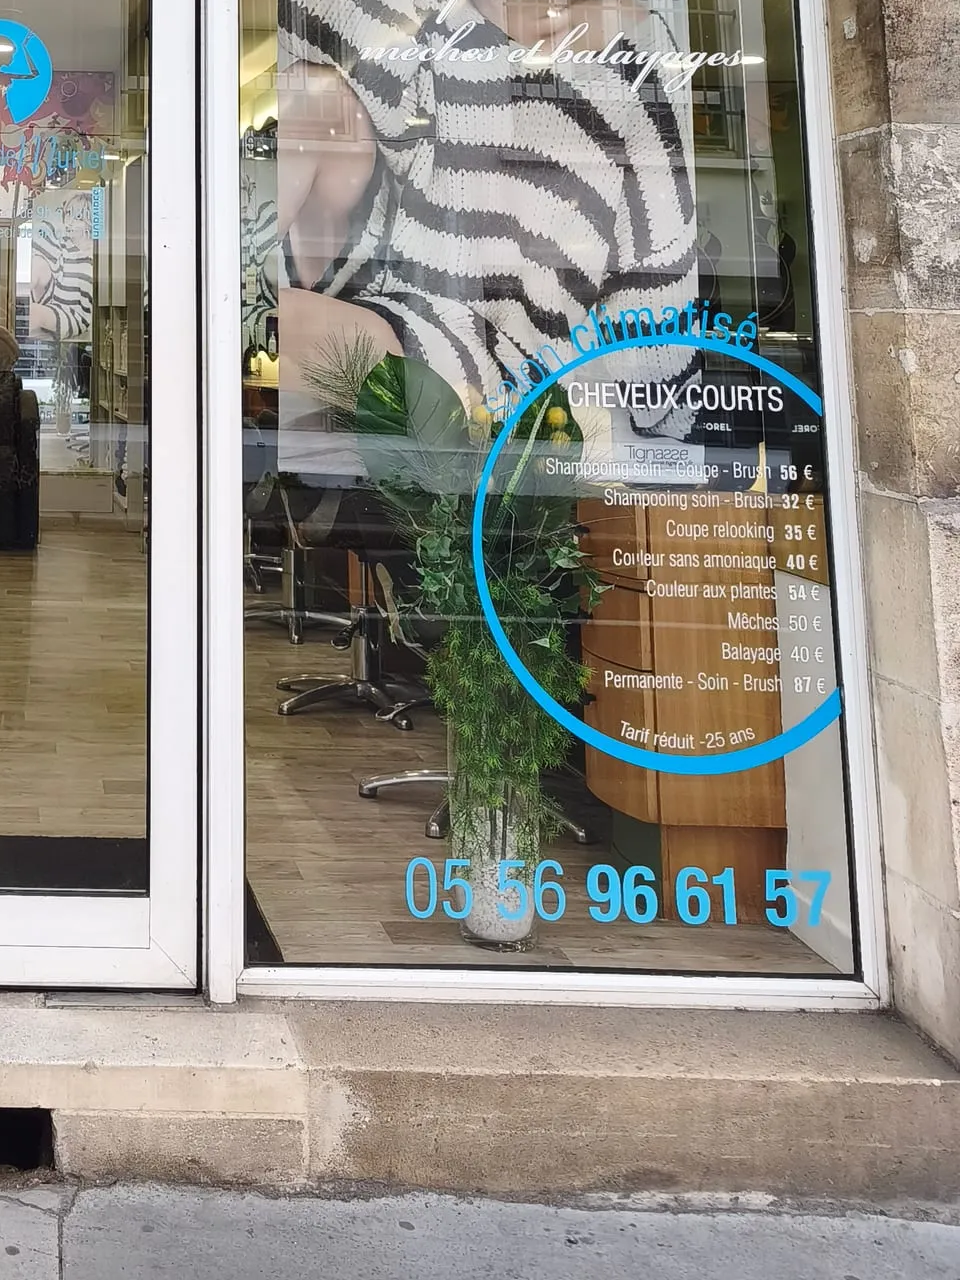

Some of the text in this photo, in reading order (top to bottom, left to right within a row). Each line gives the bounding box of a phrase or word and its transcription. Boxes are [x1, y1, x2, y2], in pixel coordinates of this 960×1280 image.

[361, 21, 744, 94] mèches et balayages
[570, 300, 759, 352] climatisé
[567, 381, 784, 412] CHEVEUX COURTS
[546, 457, 629, 481] Shampooing
[633, 461, 661, 478] soin
[677, 462, 719, 482] Coupe
[733, 463, 771, 480] Brush
[780, 465, 798, 480] 56
[804, 465, 813, 480] €
[604, 489, 687, 510] Shampooing
[692, 491, 720, 508] soin
[735, 492, 773, 509] Brush
[782, 493, 800, 509] 32
[805, 494, 815, 510] €
[666, 519, 817, 543] Coupe relooking 35 €
[613, 548, 818, 572] Couleur sans amoniaque 40 €
[646, 580, 821, 602] Couleur aux plantes 54 €
[727, 611, 822, 632] Mêches 50 €
[721, 643, 824, 664] Balayage 40 €
[604, 671, 683, 690] Permanente
[698, 673, 728, 690] Soin
[743, 674, 783, 692] Brush
[794, 677, 812, 694] 87
[817, 678, 826, 694] €
[620, 720, 756, 750] Tarif réduit -25 ans
[405, 856, 832, 927] 05 56 96 61 57
